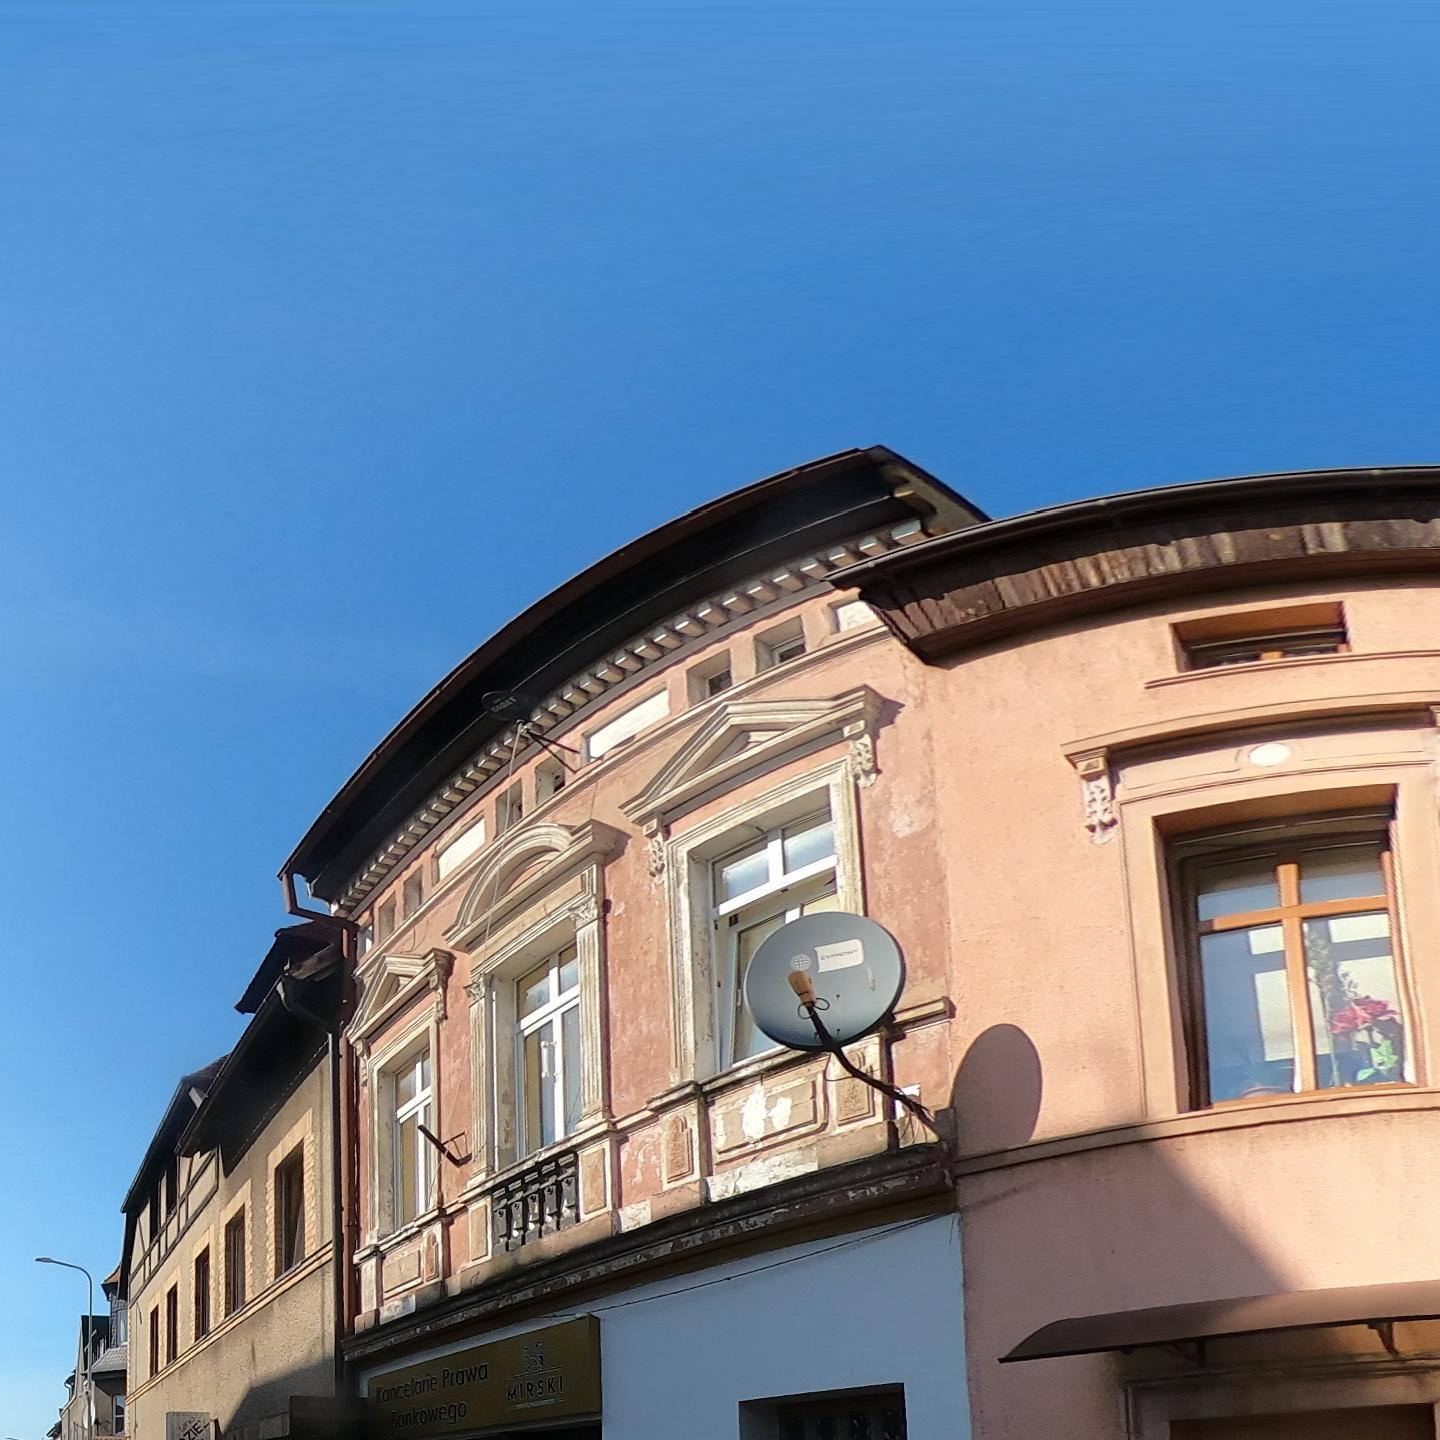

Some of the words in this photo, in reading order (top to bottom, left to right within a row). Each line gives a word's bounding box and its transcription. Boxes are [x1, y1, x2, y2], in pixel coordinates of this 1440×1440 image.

[376, 1373, 439, 1404] Kancelarie
[442, 1362, 489, 1389] Prawa
[507, 1375, 564, 1401] MIRSKI
[391, 1401, 468, 1430] Bankowego
